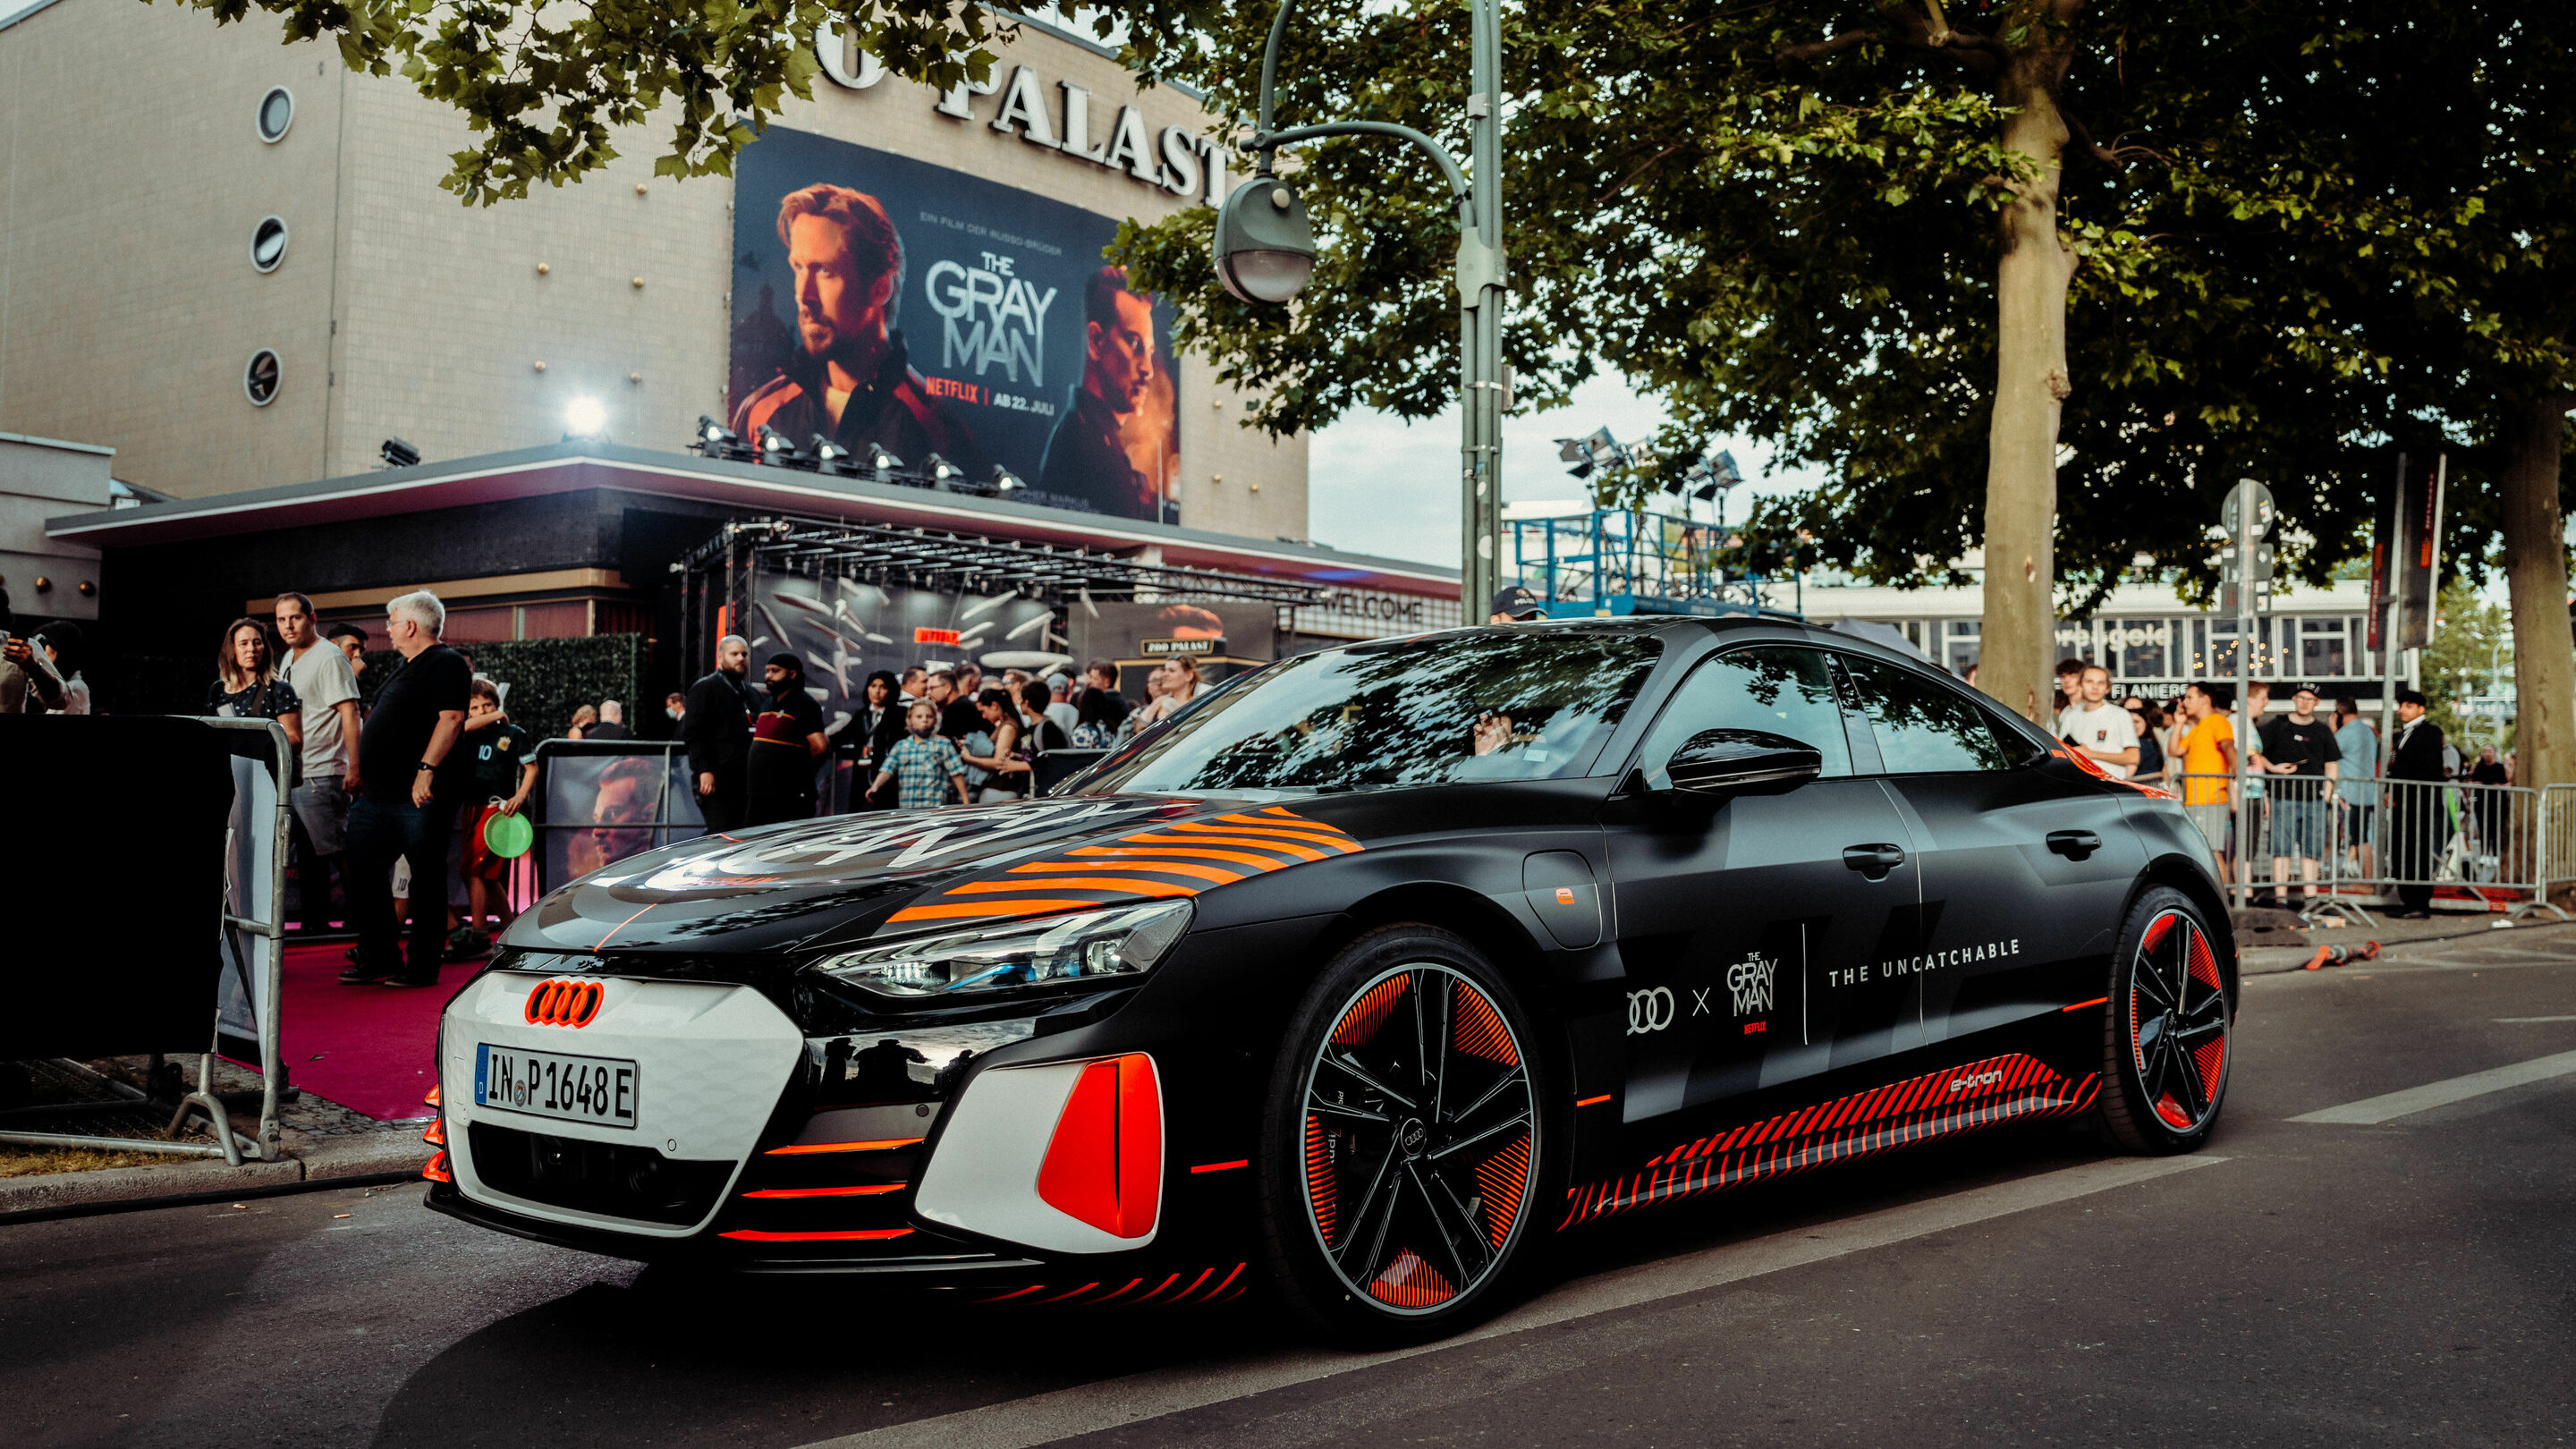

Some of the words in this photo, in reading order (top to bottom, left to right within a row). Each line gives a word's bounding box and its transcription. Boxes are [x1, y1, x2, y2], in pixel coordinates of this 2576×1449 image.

[941, 216, 964, 231] FILM
[981, 250, 1014, 277] THE
[926, 259, 1058, 338] GRAY
[943, 313, 1043, 387] MAN
[925, 376, 979, 404] NETFLIX
[994, 392, 1011, 408] AB
[1030, 399, 1055, 417] JULI
[1323, 592, 1423, 623] WELCOME
[478, 744, 493, 761] 10
[1747, 952, 1761, 962] THE
[1829, 965, 1868, 987] THE
[1883, 938, 2020, 978] UNCATCHABLE
[1727, 958, 1778, 990] GRAY
[1733, 986, 1773, 1017] MAN
[1743, 1021, 1767, 1035] NETFLIX
[479, 1081, 485, 1095] D
[489, 1054, 513, 1103] IN
[1951, 1070, 2003, 1092] e-tron
[1327, 1133, 1336, 1165] udi
